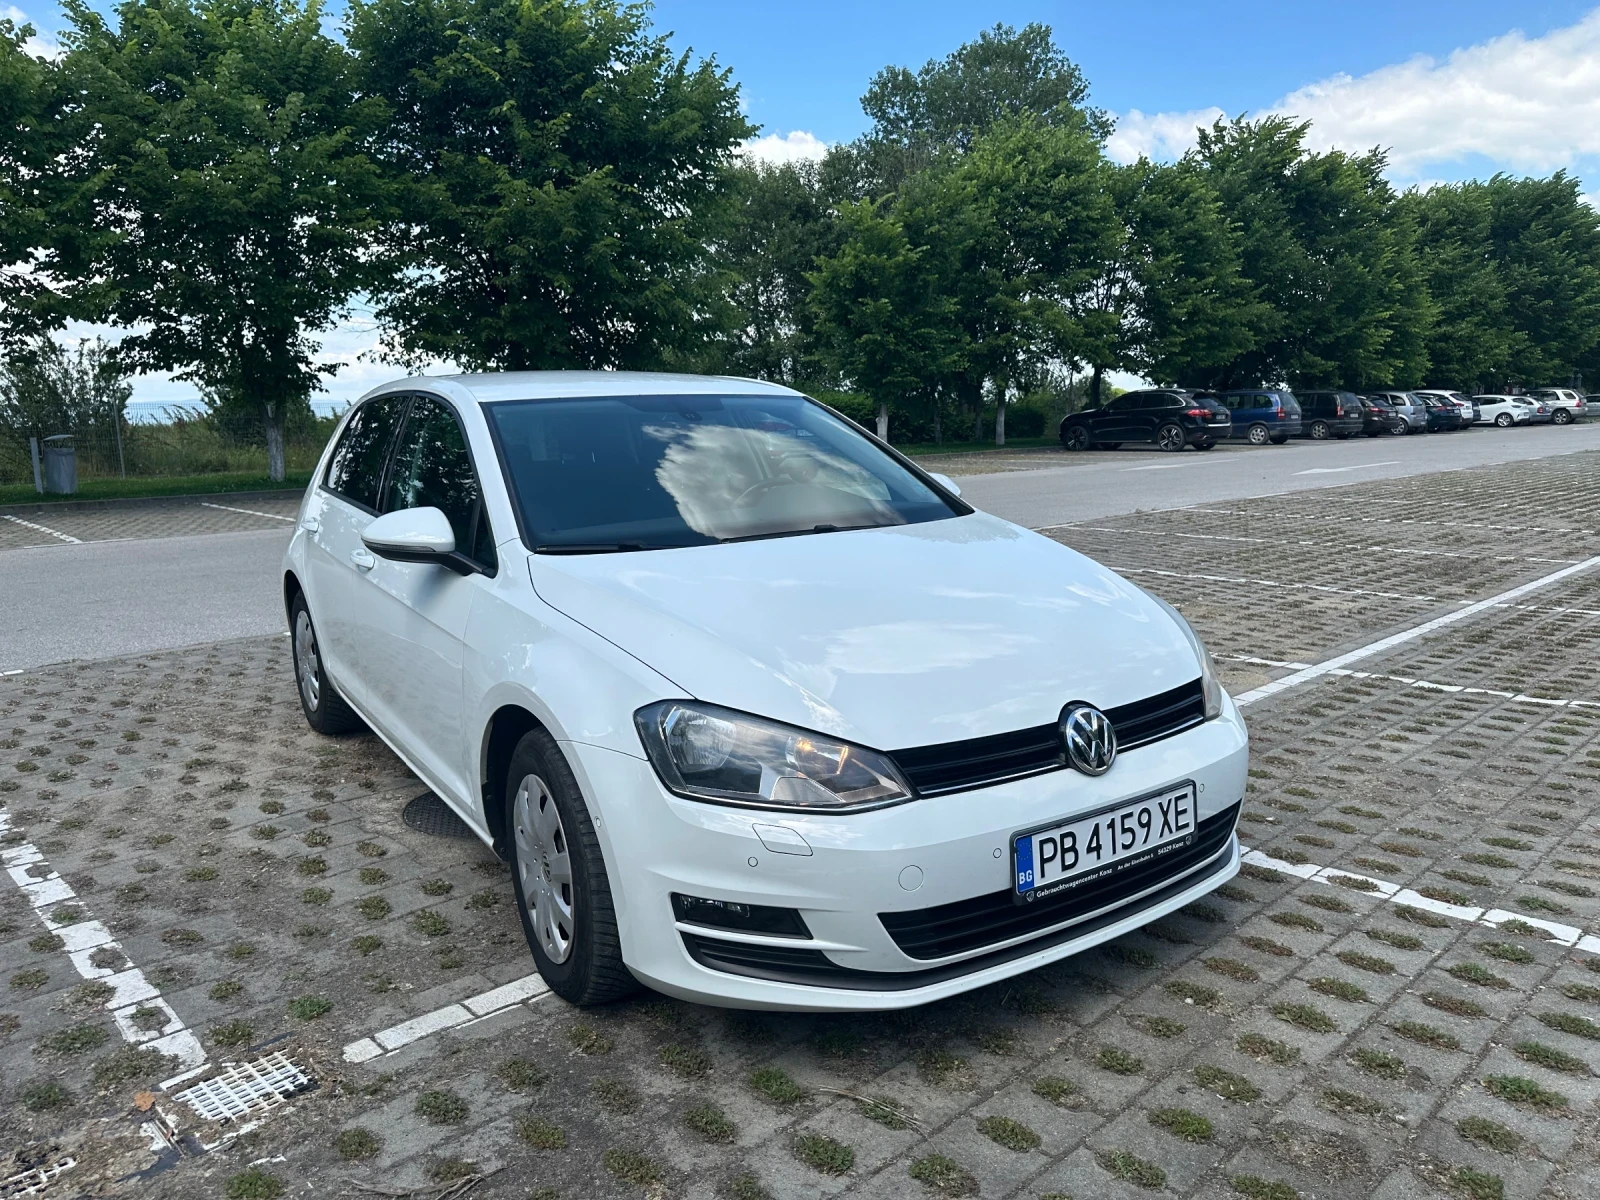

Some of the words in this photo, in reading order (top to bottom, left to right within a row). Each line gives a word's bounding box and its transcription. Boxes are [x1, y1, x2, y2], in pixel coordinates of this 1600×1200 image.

[1066, 707, 1117, 776] VW
[1038, 830, 1079, 879] PB
[1085, 806, 1152, 861] 4159
[1157, 793, 1190, 839] XE
[1018, 869, 1033, 885] BG
[1036, 873, 1099, 898] Gebrauchtwagencenter
